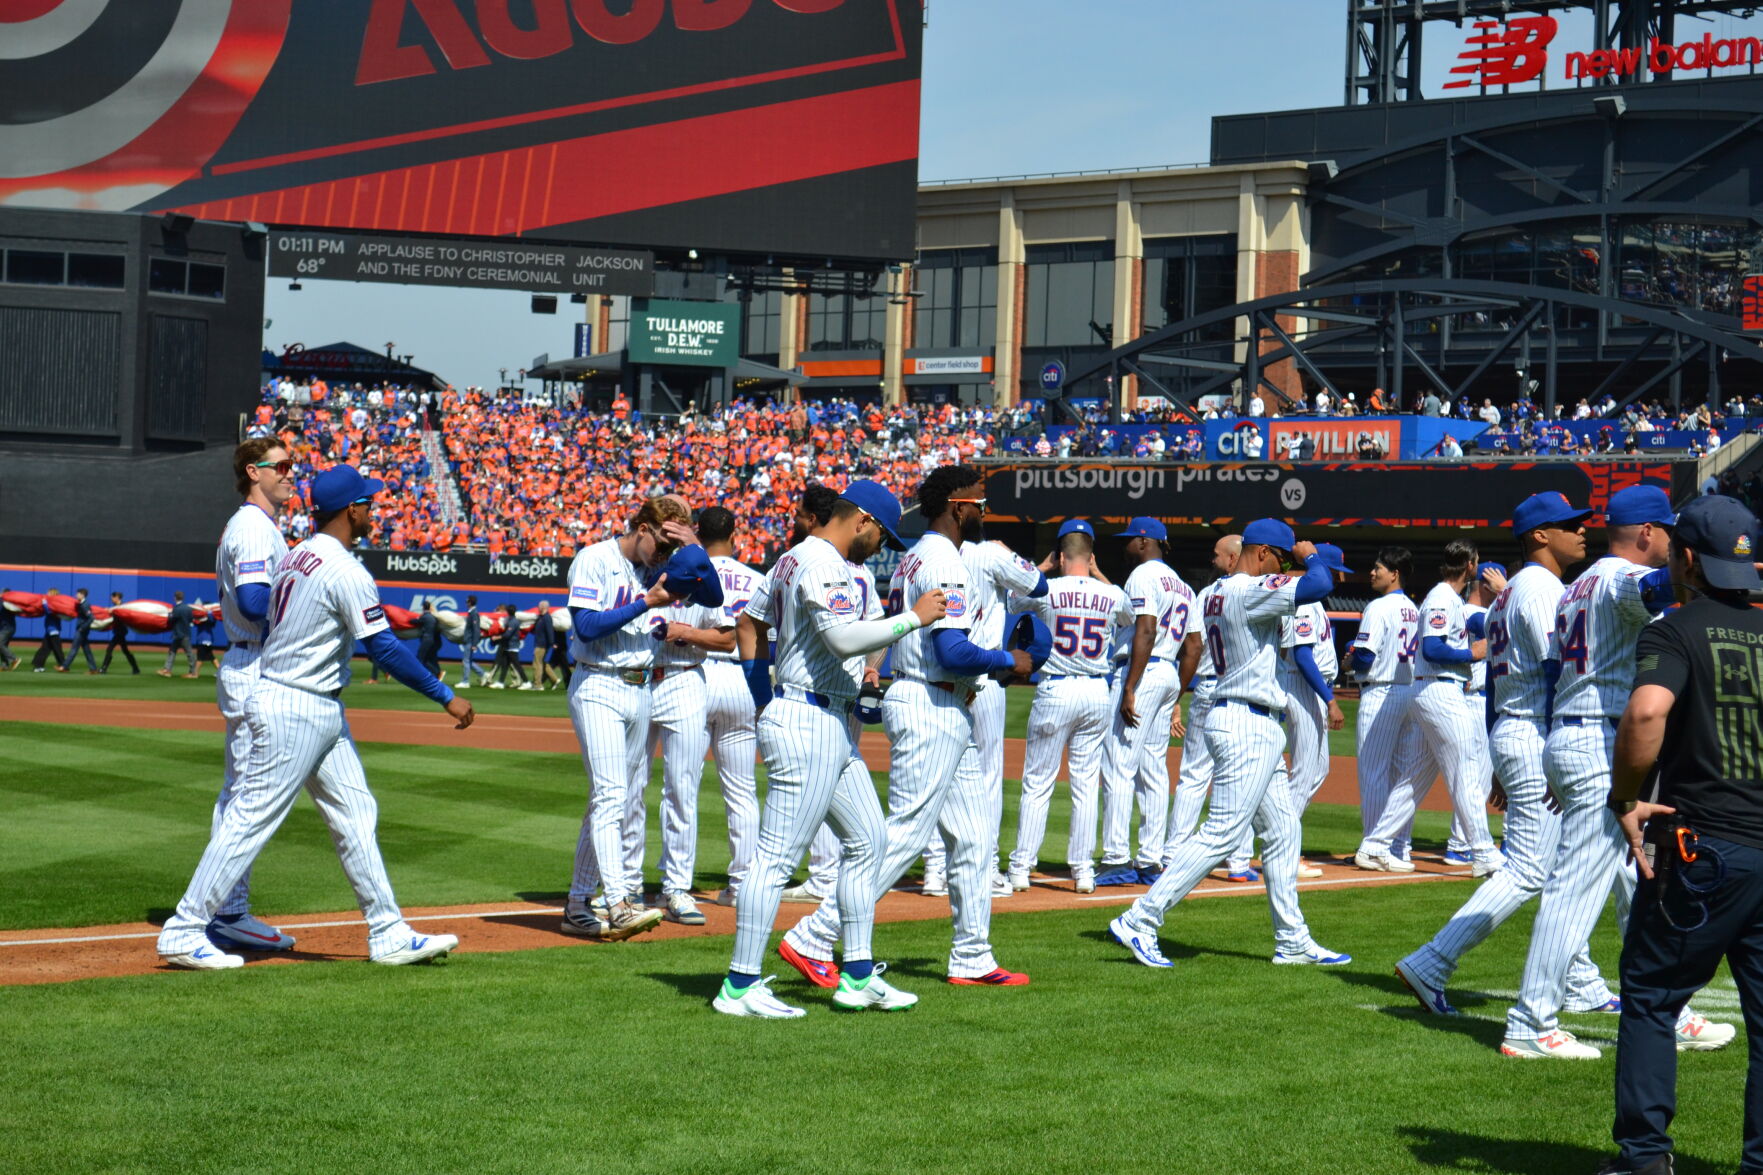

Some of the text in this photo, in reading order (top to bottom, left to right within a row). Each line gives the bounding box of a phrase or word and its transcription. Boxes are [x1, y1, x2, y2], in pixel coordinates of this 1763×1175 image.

[1565, 32, 1763, 80] new balan
[278, 237, 345, 254] 01:11 PM
[358, 243, 643, 270] APPLAUSE TO CHRISTOPHER JACKSON
[296, 257, 326, 273] 68°
[357, 261, 605, 286] AND THE FDNY CEREMONIAL UNIT
[646, 317, 724, 334] TULLAMORE
[678, 348, 713, 356] WHISKEY
[926, 361, 946, 369] center
[962, 360, 979, 370] shop
[1218, 425, 1389, 455] cit PVILIN
[1651, 436, 1666, 445] citi
[1015, 468, 1165, 499] pittsburgh
[387, 554, 457, 575] HubSpot
[1050, 591, 1116, 614] LOVELADY
[1160, 600, 1189, 642] 43
[1054, 614, 1107, 659] 55
